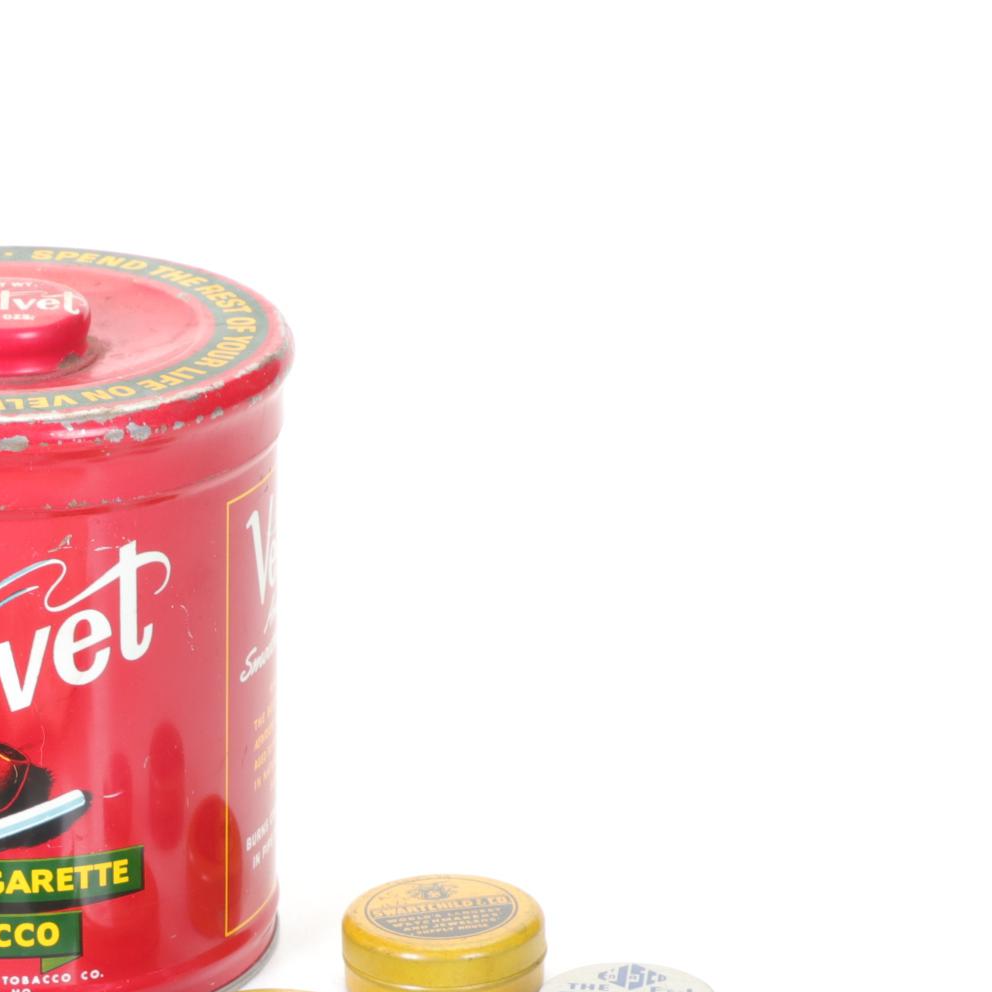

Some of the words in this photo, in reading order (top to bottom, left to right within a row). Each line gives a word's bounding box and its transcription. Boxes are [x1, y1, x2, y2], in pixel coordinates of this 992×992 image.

[31, 250, 148, 270] SPEND
[150, 265, 209, 287] THE
[195, 285, 252, 313] REST
[226, 317, 256, 332] OF
[194, 335, 254, 368] YOUR
[136, 366, 207, 390] LIFE
[81, 386, 136, 401] ON
[2, 973, 71, 986] TOBACCO
[81, 969, 104, 980] CO.
